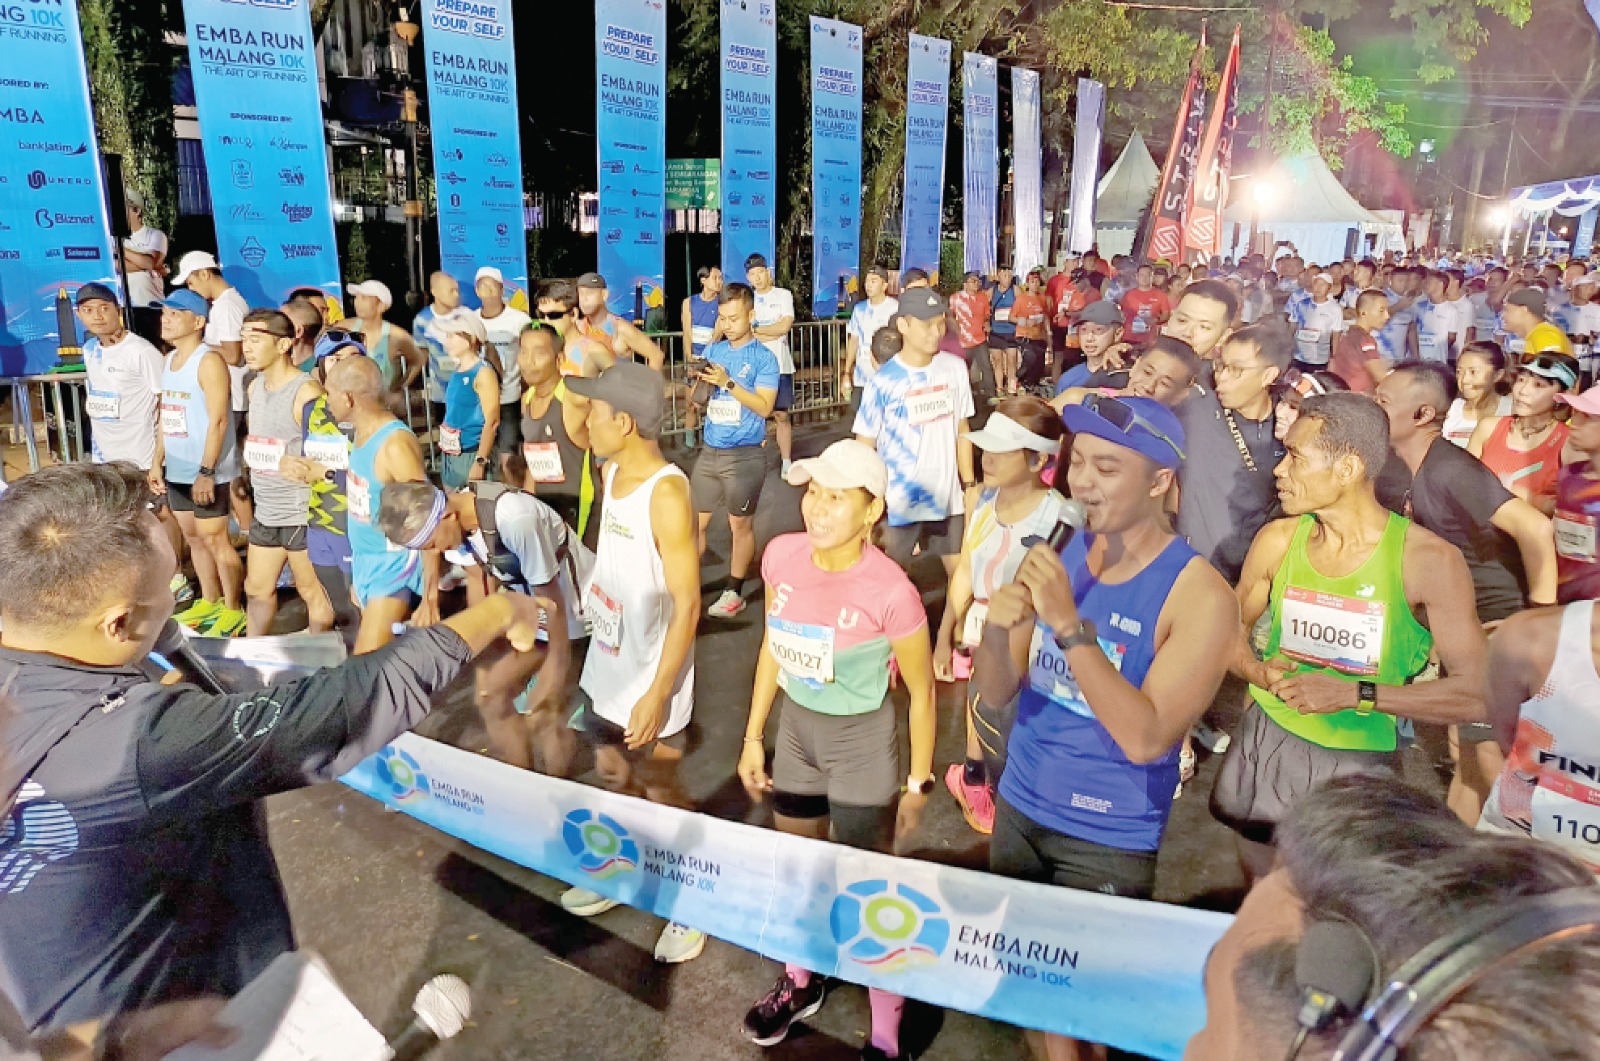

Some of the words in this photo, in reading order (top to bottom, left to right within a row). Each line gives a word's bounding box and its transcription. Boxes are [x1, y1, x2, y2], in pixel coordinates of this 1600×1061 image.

[30, 9, 64, 27] 10K
[436, 0, 496, 18] PREPARE
[10, 28, 67, 44] RUNNING
[431, 15, 468, 31] YOUR
[473, 22, 504, 37] SELF
[607, 26, 653, 46] PREPARE
[196, 24, 258, 46] EMBA
[261, 31, 304, 50] RUN
[199, 45, 276, 66] MALANG
[279, 54, 305, 68] 10K
[602, 41, 630, 55] YOUR
[635, 49, 658, 62] SELF
[729, 44, 766, 58] PREPARE
[202, 65, 223, 76] THE
[225, 68, 244, 78] ART
[247, 70, 260, 79] OF
[263, 71, 307, 83] RUNNING
[432, 52, 476, 71] EMBA
[478, 58, 508, 75] RUN
[725, 59, 749, 70] YOUR
[751, 62, 770, 73] SELF
[433, 70, 487, 88] MALANG
[489, 78, 508, 91] 10K
[601, 74, 634, 92] EMBA
[635, 81, 659, 97] RUN
[601, 90, 643, 108] MALANG
[54, 212, 95, 224] Biznet
[1291, 618, 1367, 650] 110086
[771, 641, 823, 671] 100127
[431, 778, 462, 800] EMBA
[462, 788, 485, 805] RUN
[433, 792, 472, 813] MALANG
[644, 845, 690, 867] EMBA
[690, 855, 721, 876] RUN
[643, 861, 695, 887] MALANG
[696, 877, 717, 893] 10K
[957, 924, 1021, 956] EMBA
[1027, 940, 1080, 970] RUN
[953, 947, 1038, 981] MALANG
[1039, 969, 1072, 988] 10K
